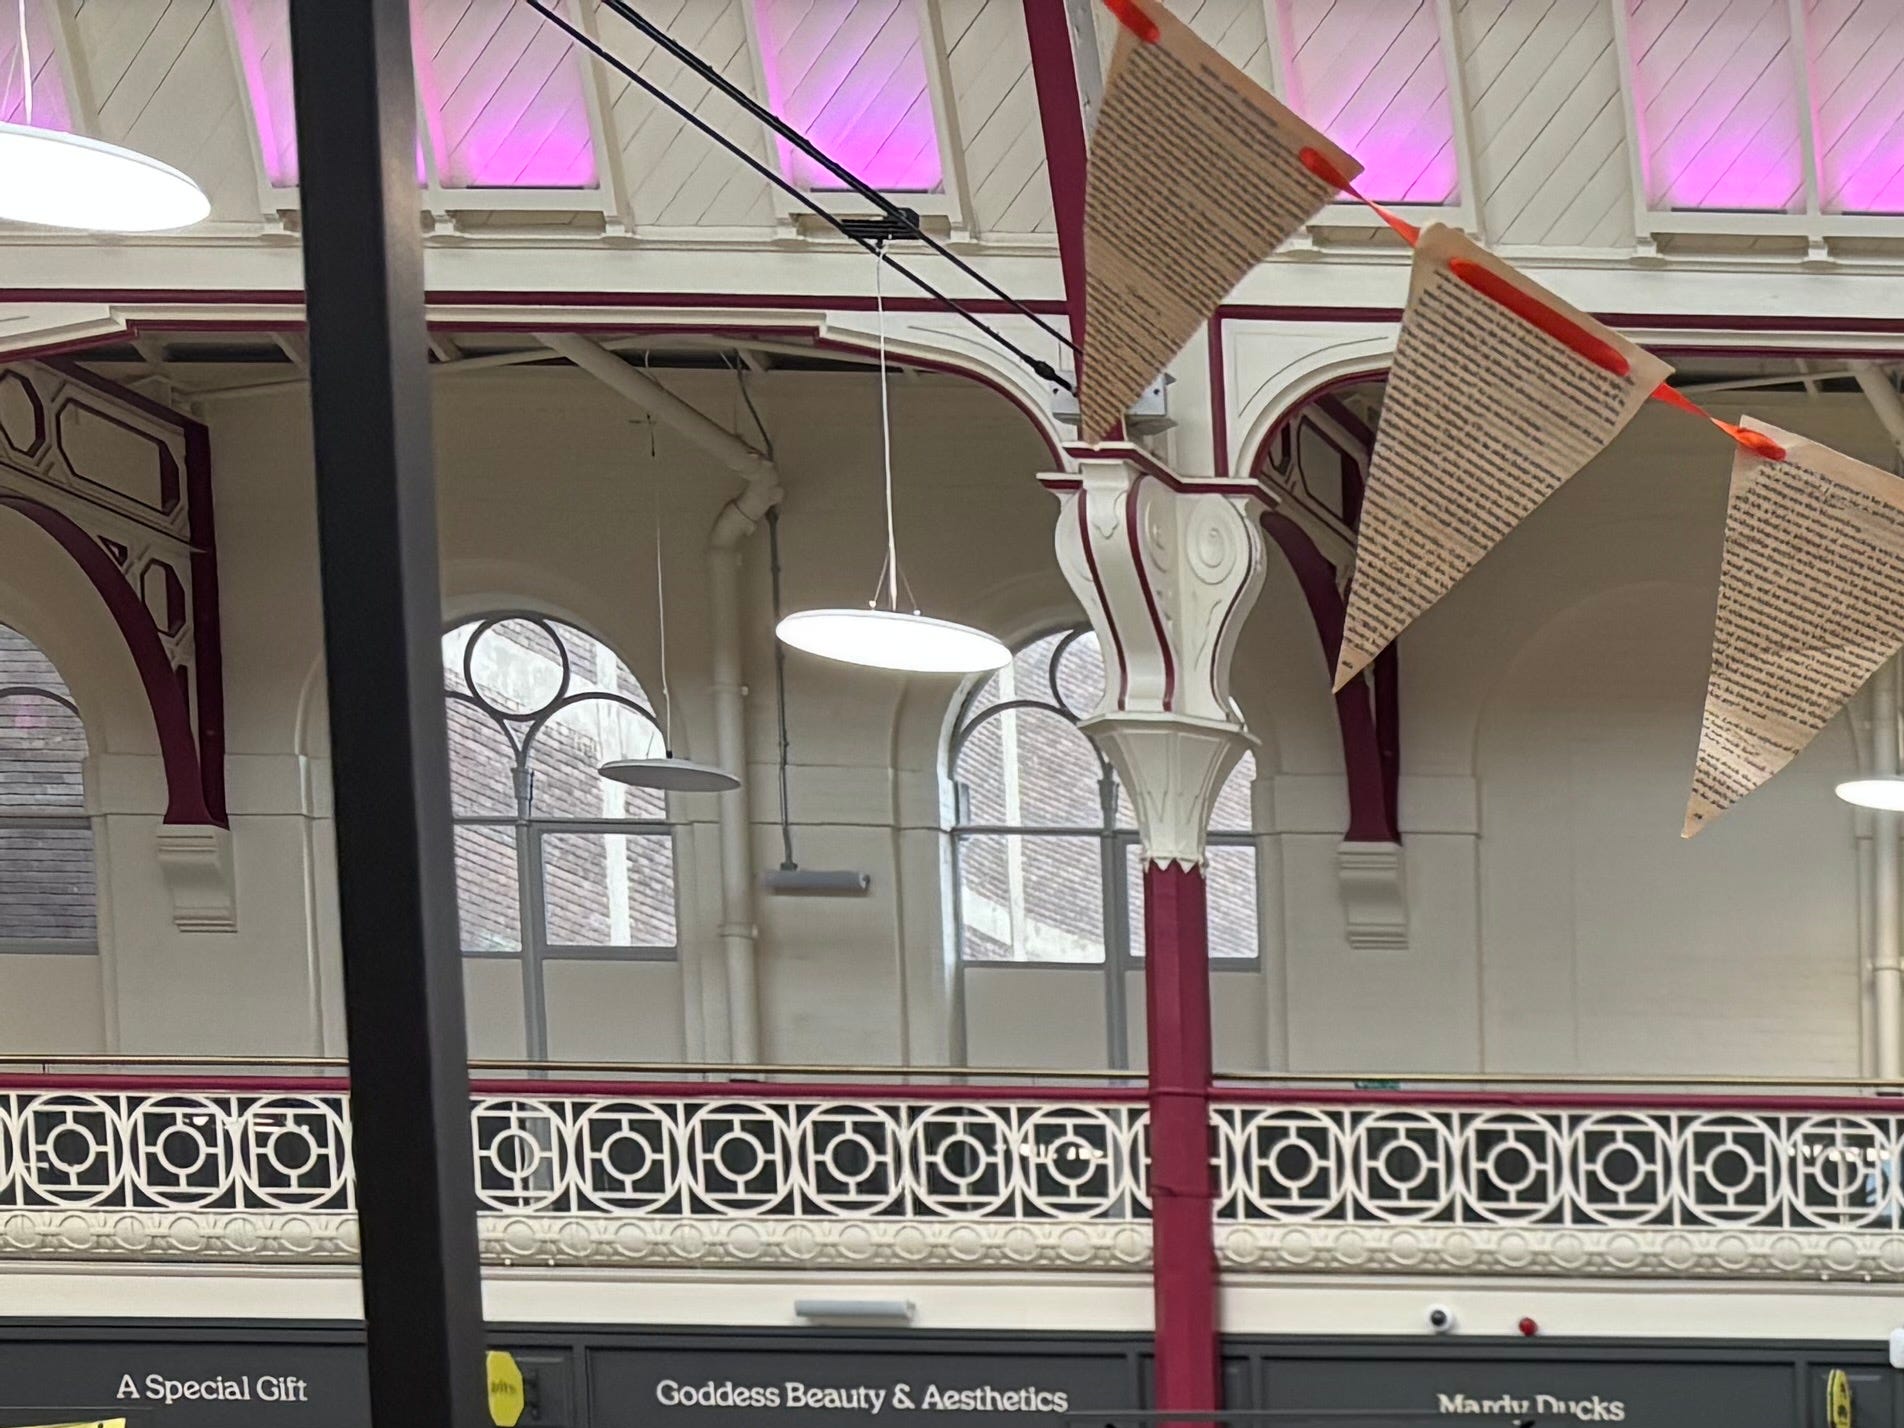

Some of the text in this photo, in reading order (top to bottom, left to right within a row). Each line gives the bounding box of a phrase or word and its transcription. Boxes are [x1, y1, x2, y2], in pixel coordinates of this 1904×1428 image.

[116, 1374, 308, 1404] A Special Gift
[656, 1379, 1068, 1414] Goddess Beauty & Aesthetics
